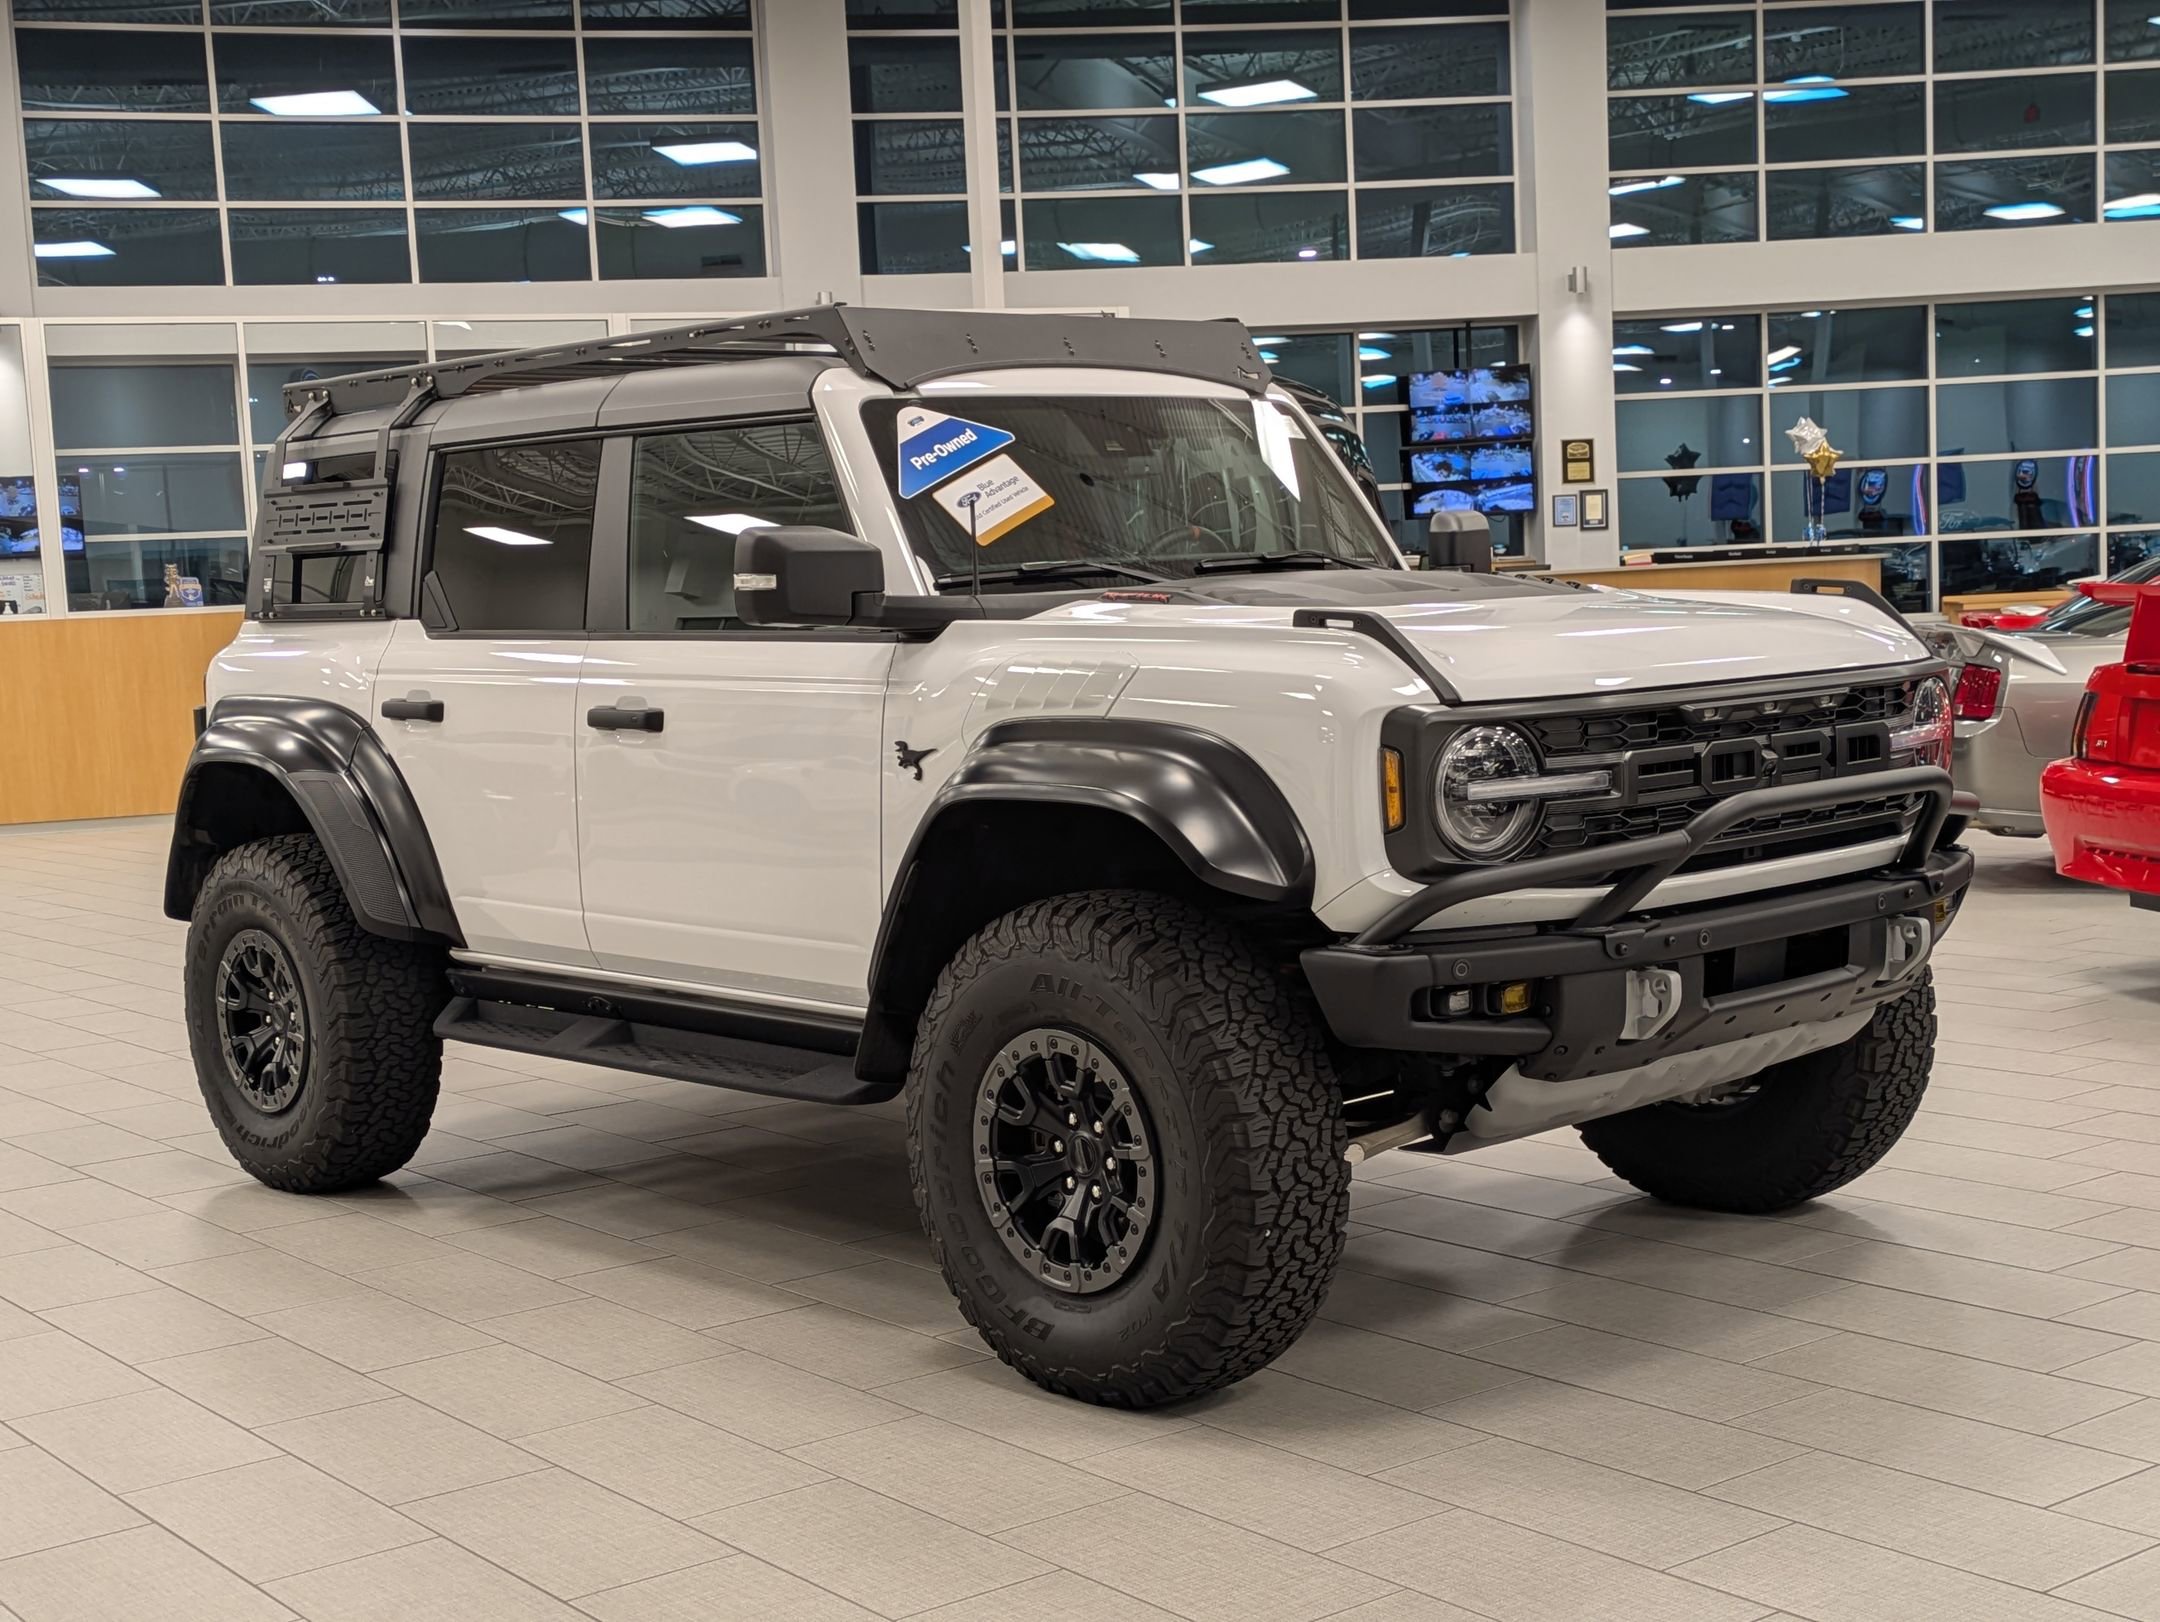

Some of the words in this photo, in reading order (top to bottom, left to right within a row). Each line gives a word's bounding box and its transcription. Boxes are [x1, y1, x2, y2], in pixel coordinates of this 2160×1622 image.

[909, 427, 979, 471] Pre-Owned
[976, 479, 995, 491] Blue
[984, 475, 1020, 498] Advantage
[982, 501, 1002, 515] Certified
[1001, 495, 1014, 505] Used
[1624, 719, 1891, 804] FORD
